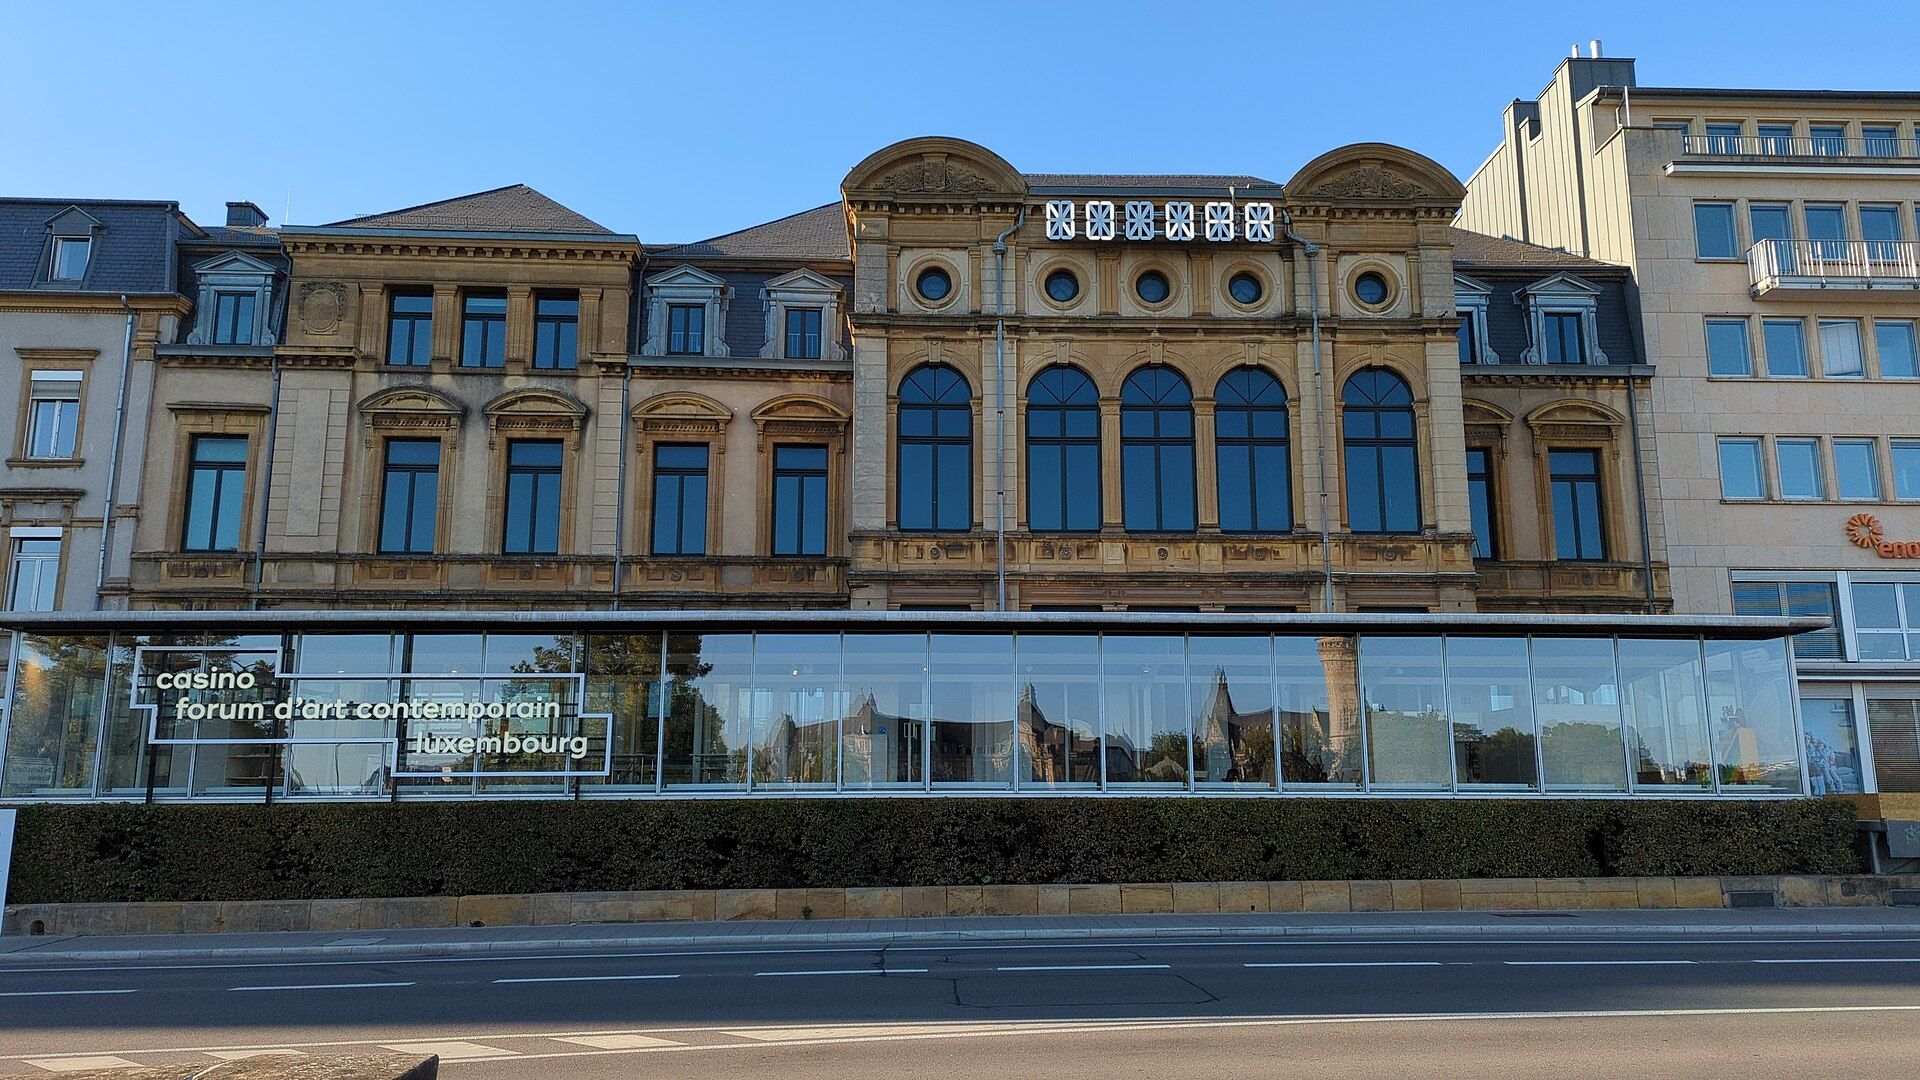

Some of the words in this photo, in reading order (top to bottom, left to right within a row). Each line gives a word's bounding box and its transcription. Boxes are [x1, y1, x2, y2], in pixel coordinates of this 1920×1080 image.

[1877, 541, 1920, 559] eno
[156, 666, 255, 690] casino
[175, 696, 264, 720] forum
[356, 696, 560, 723] contemporain
[416, 731, 588, 759] luxembourg
